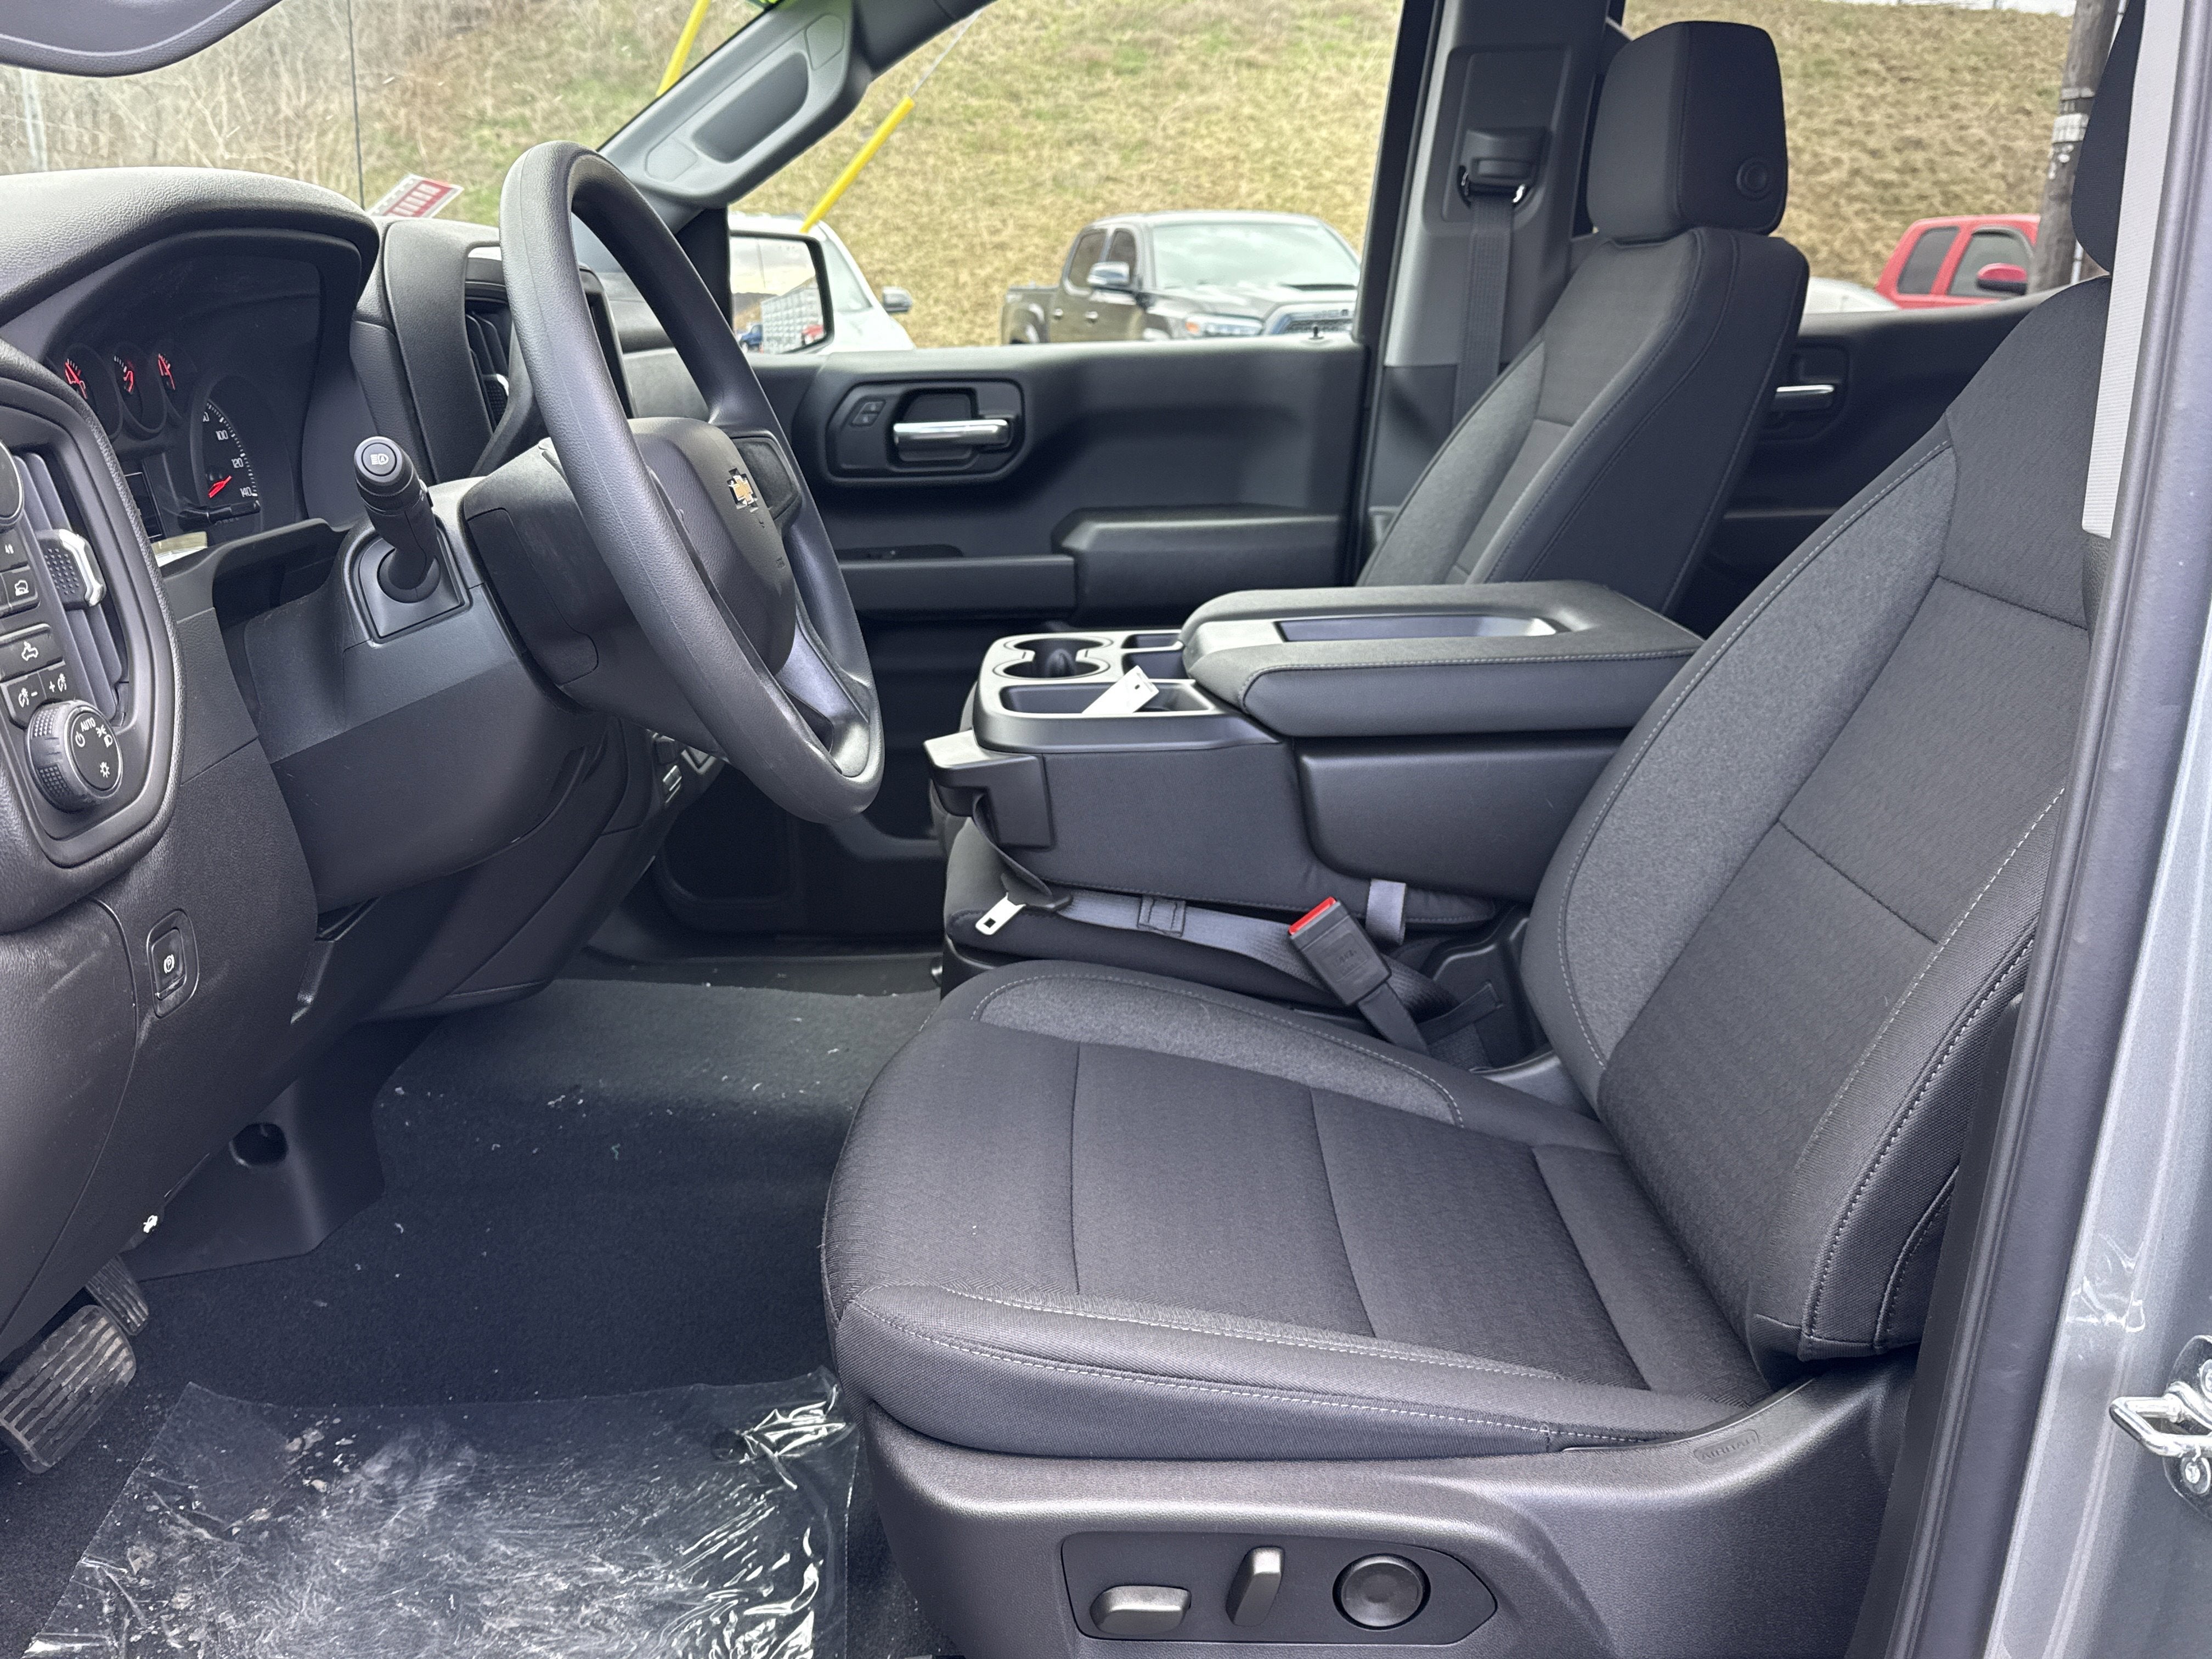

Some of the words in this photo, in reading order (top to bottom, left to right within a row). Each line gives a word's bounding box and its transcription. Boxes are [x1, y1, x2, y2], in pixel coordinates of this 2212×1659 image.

[216, 430, 228, 441] 100
[231, 458, 244, 468] 120
[240, 487, 252, 498] 140
[80, 717, 96, 732] AUTO
